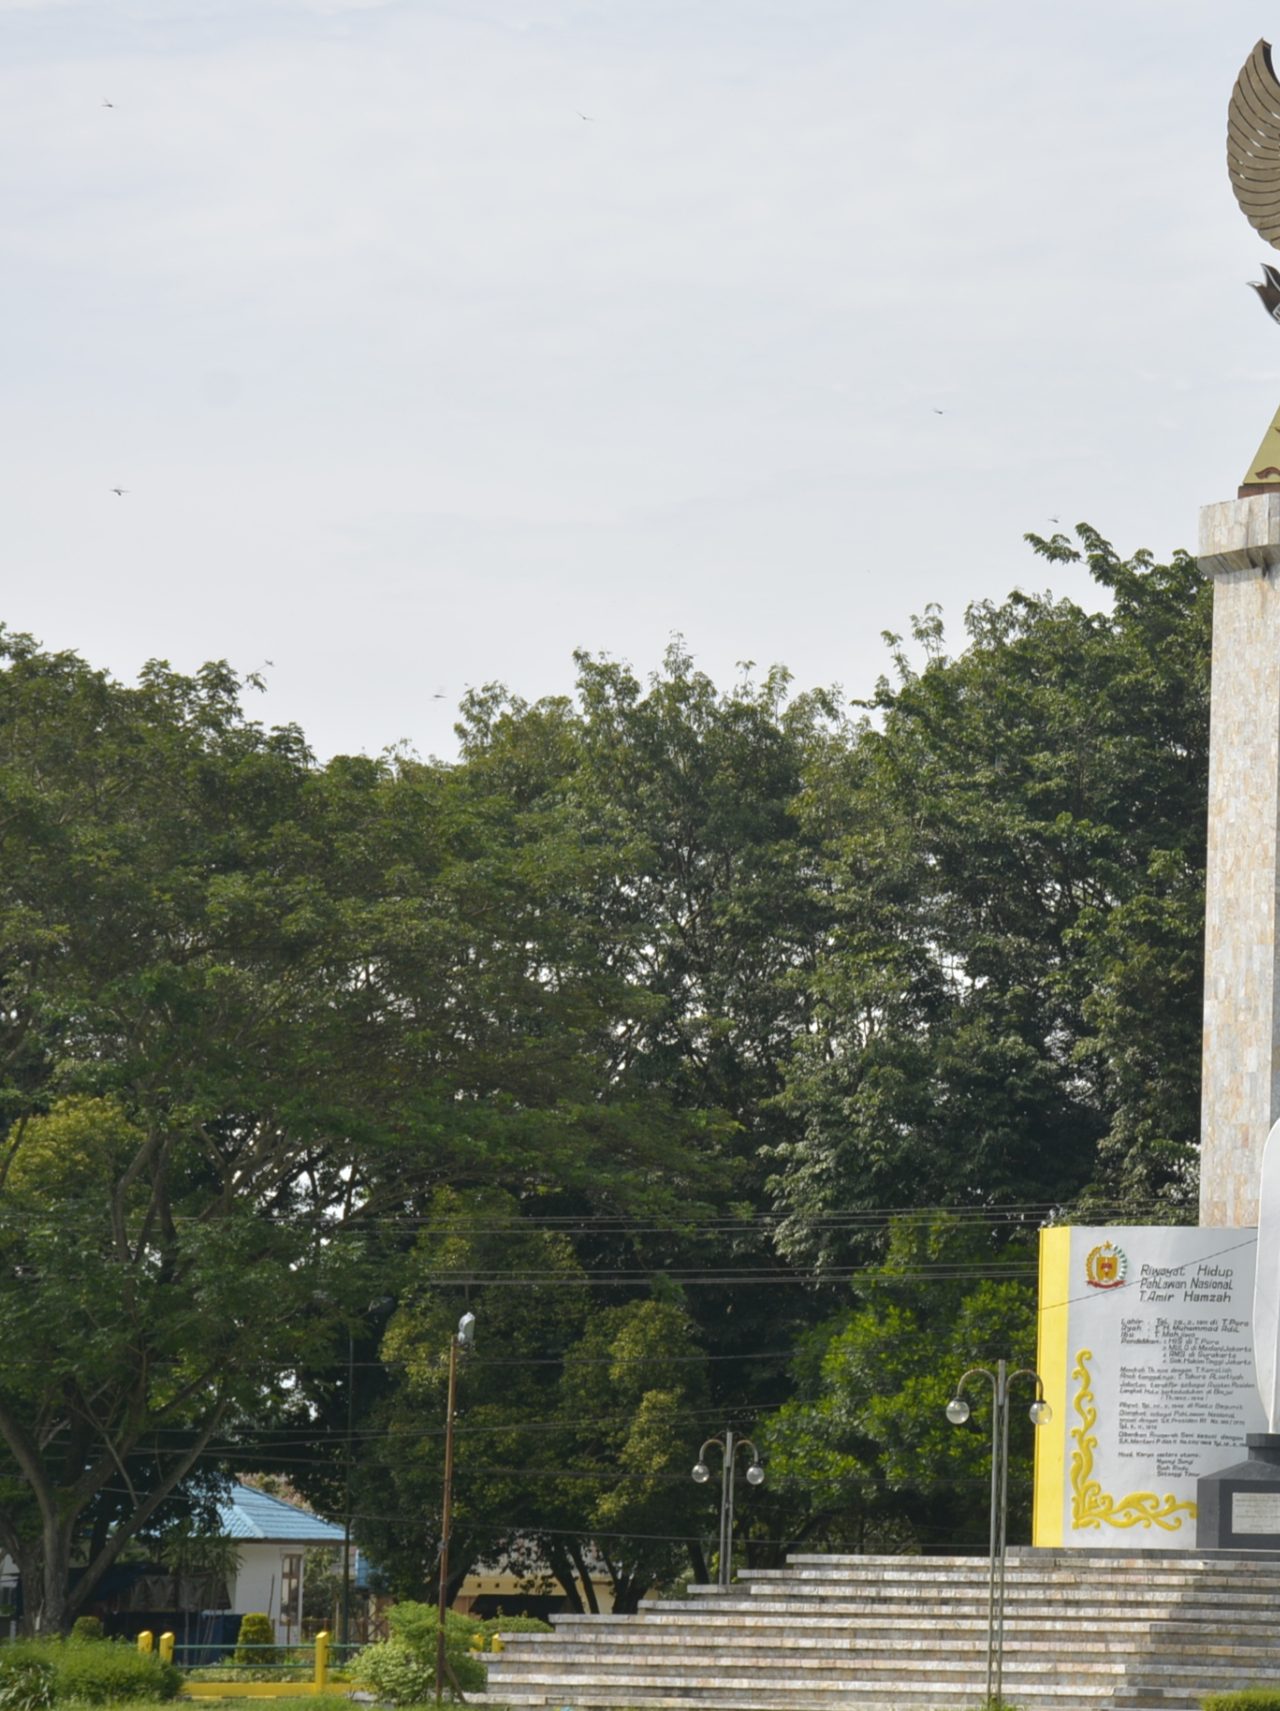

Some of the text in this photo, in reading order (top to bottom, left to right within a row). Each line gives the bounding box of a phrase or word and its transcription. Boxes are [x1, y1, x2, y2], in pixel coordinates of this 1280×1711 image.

[1140, 1264, 1233, 1278] Riwayat Hidup
[1183, 1290, 1231, 1303] Hamzah
